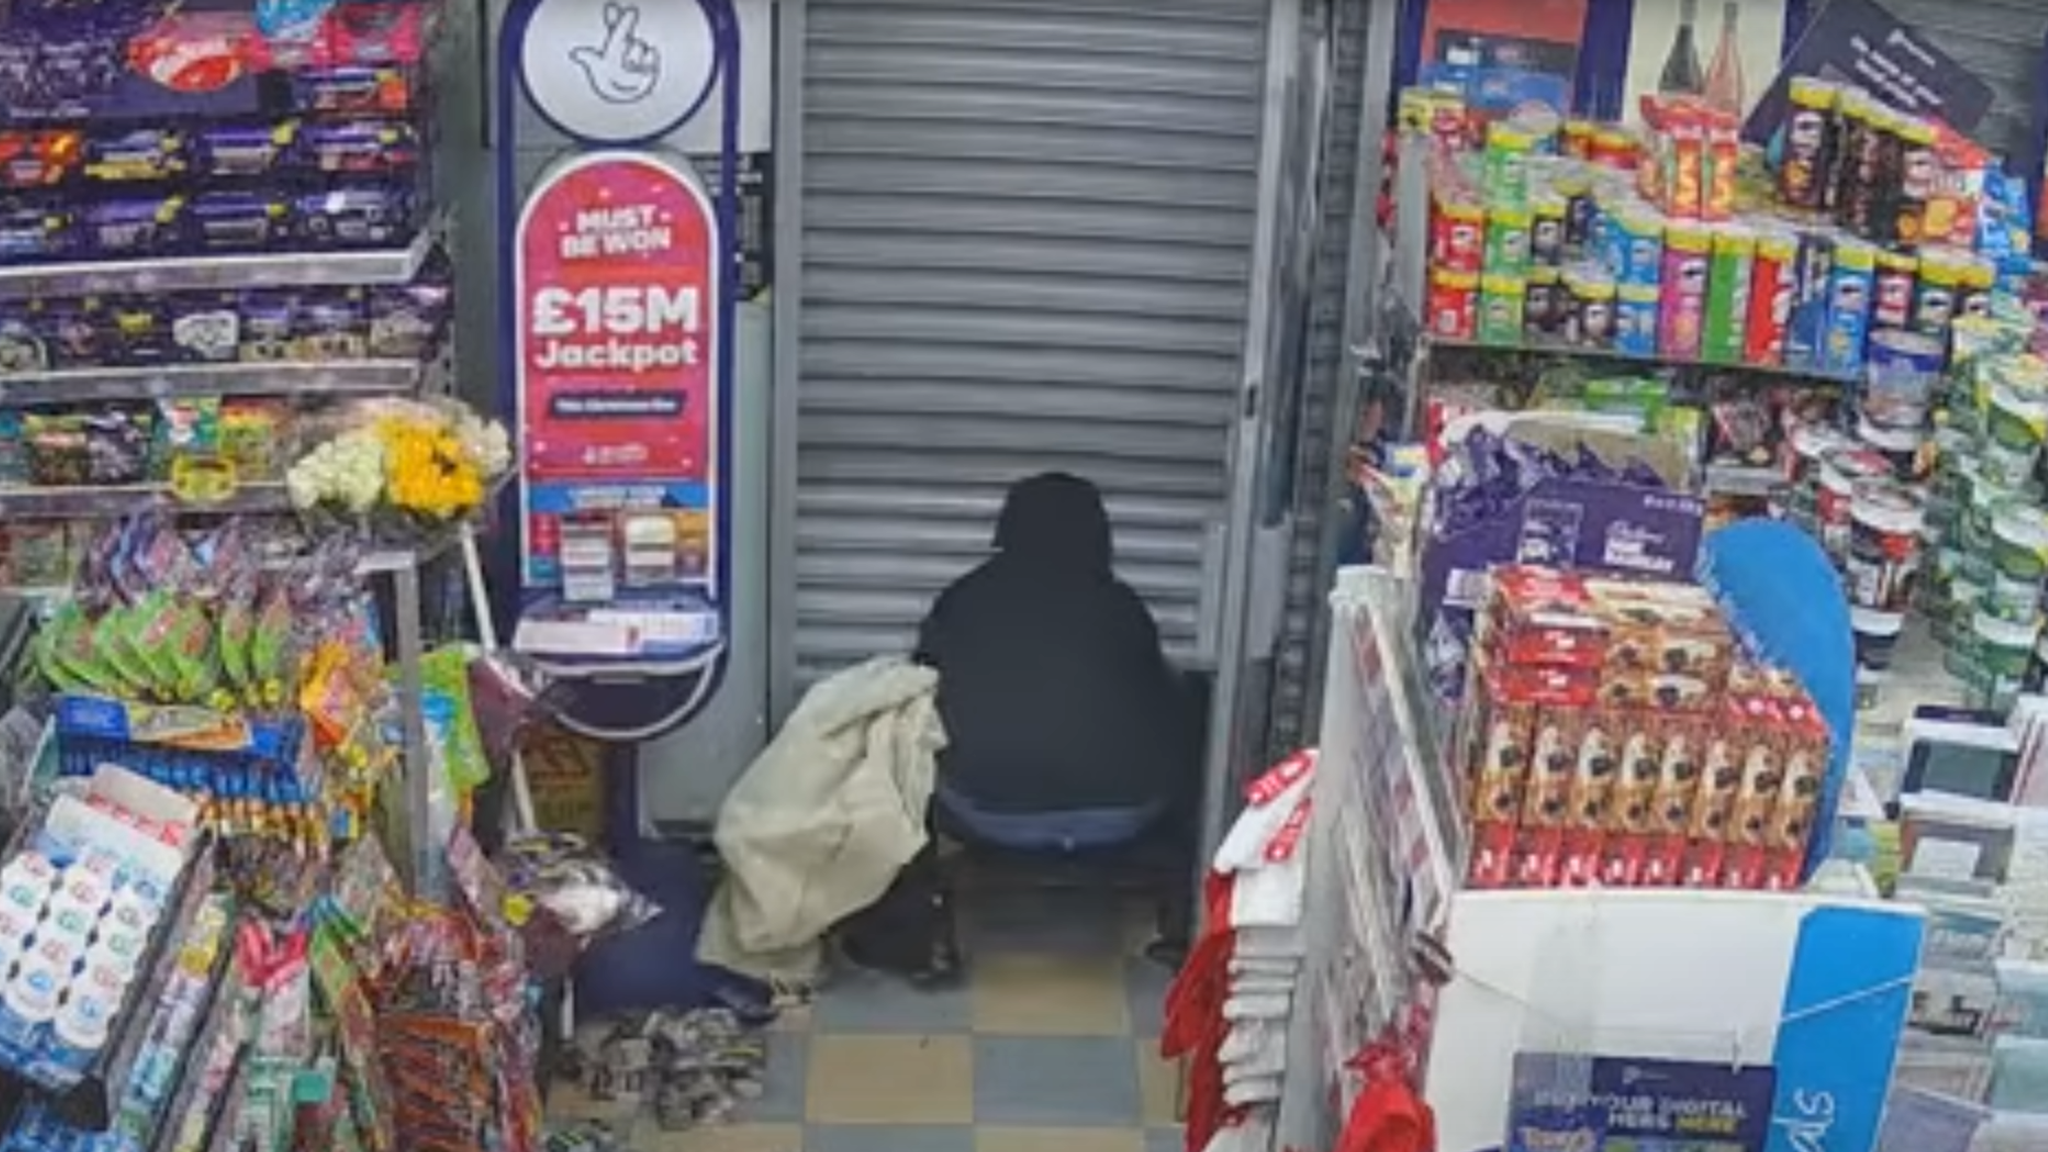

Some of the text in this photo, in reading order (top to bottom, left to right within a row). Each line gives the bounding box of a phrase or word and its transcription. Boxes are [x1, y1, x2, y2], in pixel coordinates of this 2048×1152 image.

[576, 203, 657, 233] MUST
[561, 226, 672, 259] BE WON
[532, 285, 699, 335] £15M
[532, 336, 699, 373] Jackpot
